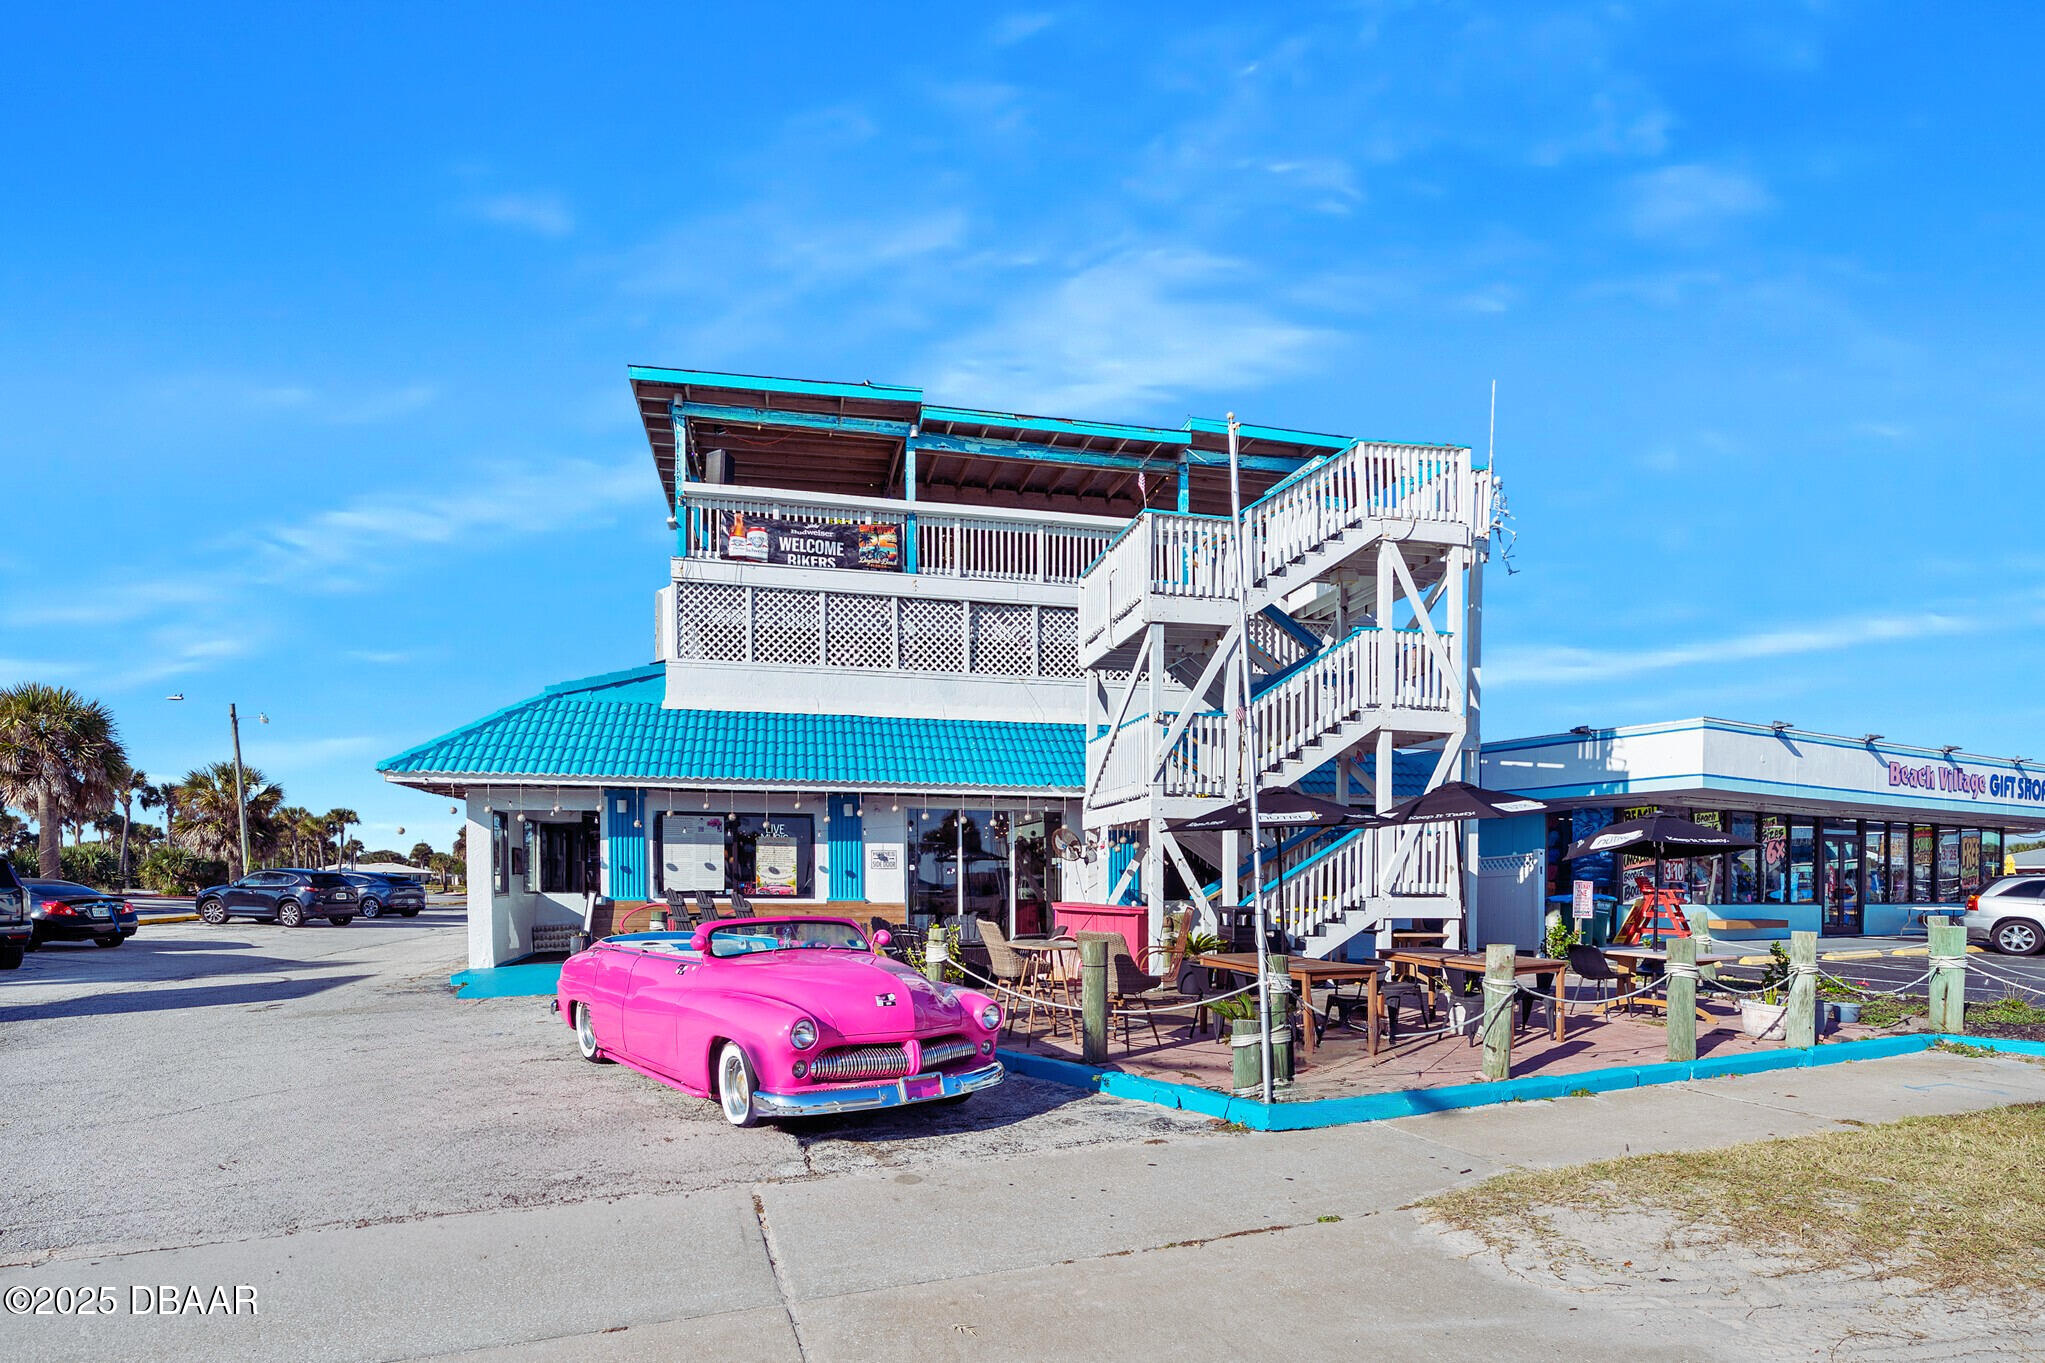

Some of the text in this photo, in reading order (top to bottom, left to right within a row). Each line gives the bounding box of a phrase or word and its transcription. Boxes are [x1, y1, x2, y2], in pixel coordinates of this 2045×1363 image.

[790, 528, 835, 538] Budweiser
[778, 536, 845, 557] WELCOME
[787, 553, 838, 568] BIKERS
[1889, 761, 1936, 790] Beach
[1938, 766, 1987, 800] Village
[1990, 773, 2017, 799] GIFT
[765, 823, 785, 834] LIVE
